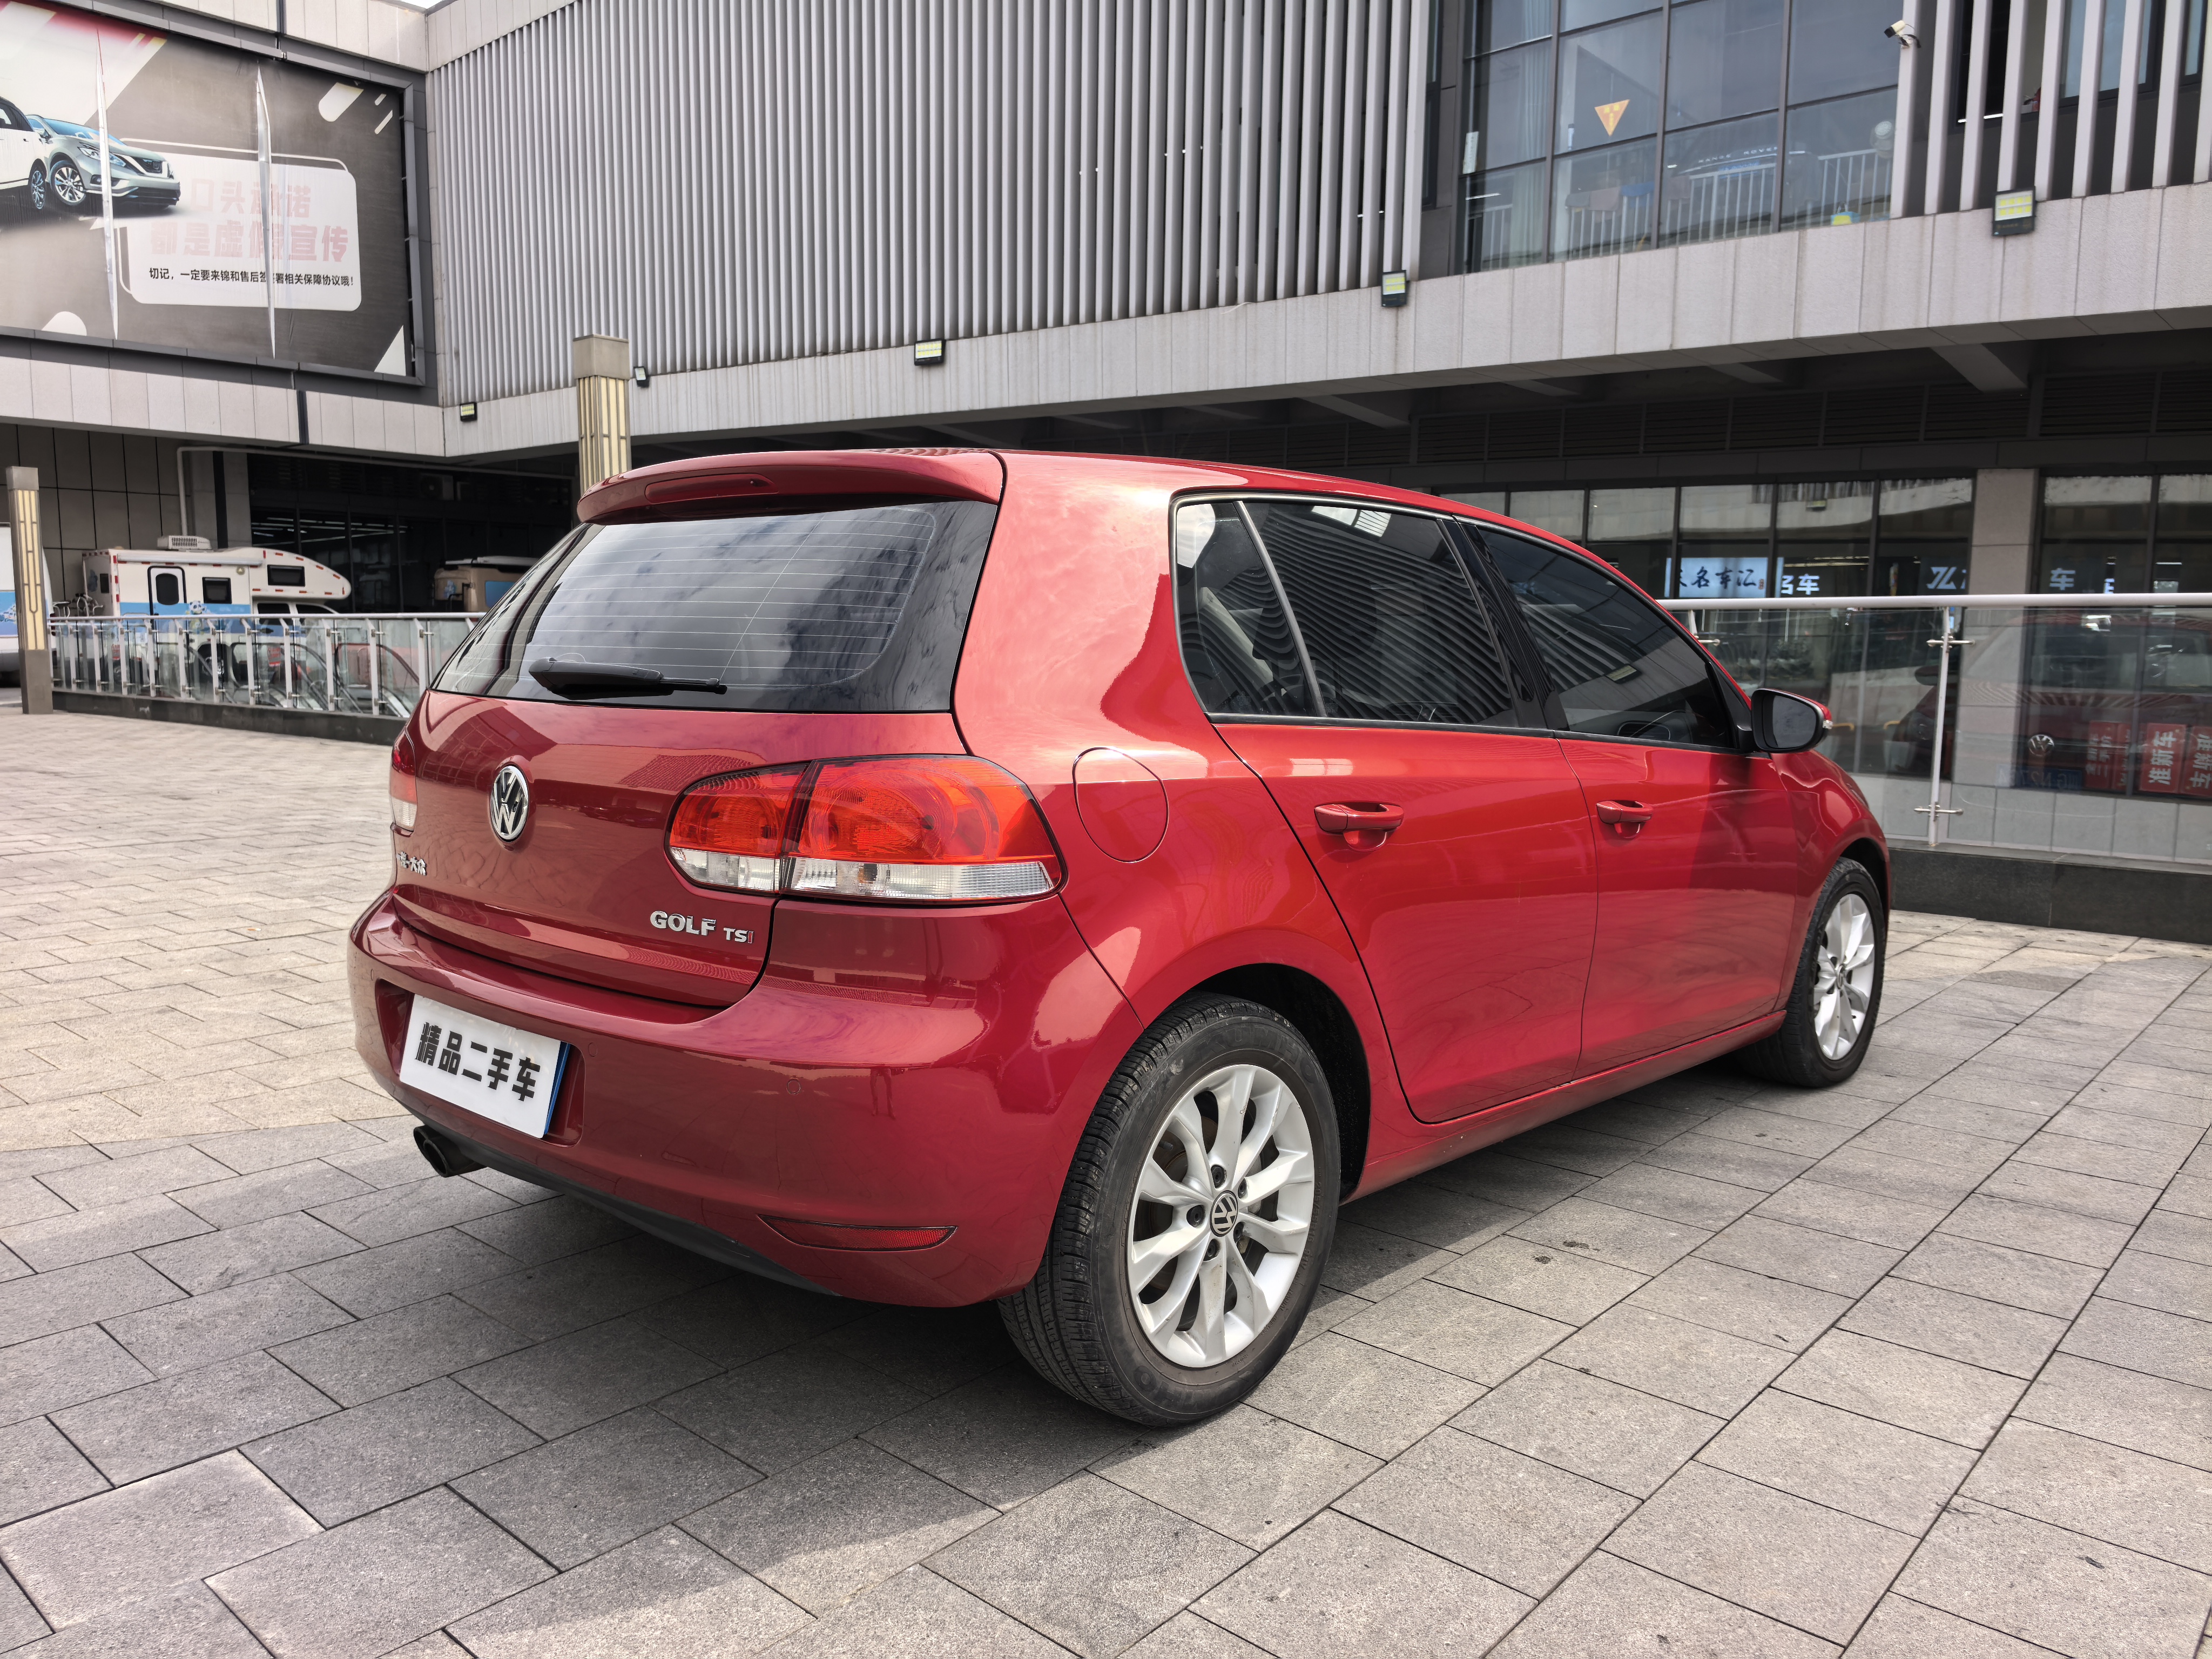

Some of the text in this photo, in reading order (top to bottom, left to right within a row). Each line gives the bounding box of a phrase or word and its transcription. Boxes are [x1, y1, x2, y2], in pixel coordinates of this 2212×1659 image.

[650, 911, 754, 944] GOLF TSI
[415, 1022, 541, 1102] 精品二手车
